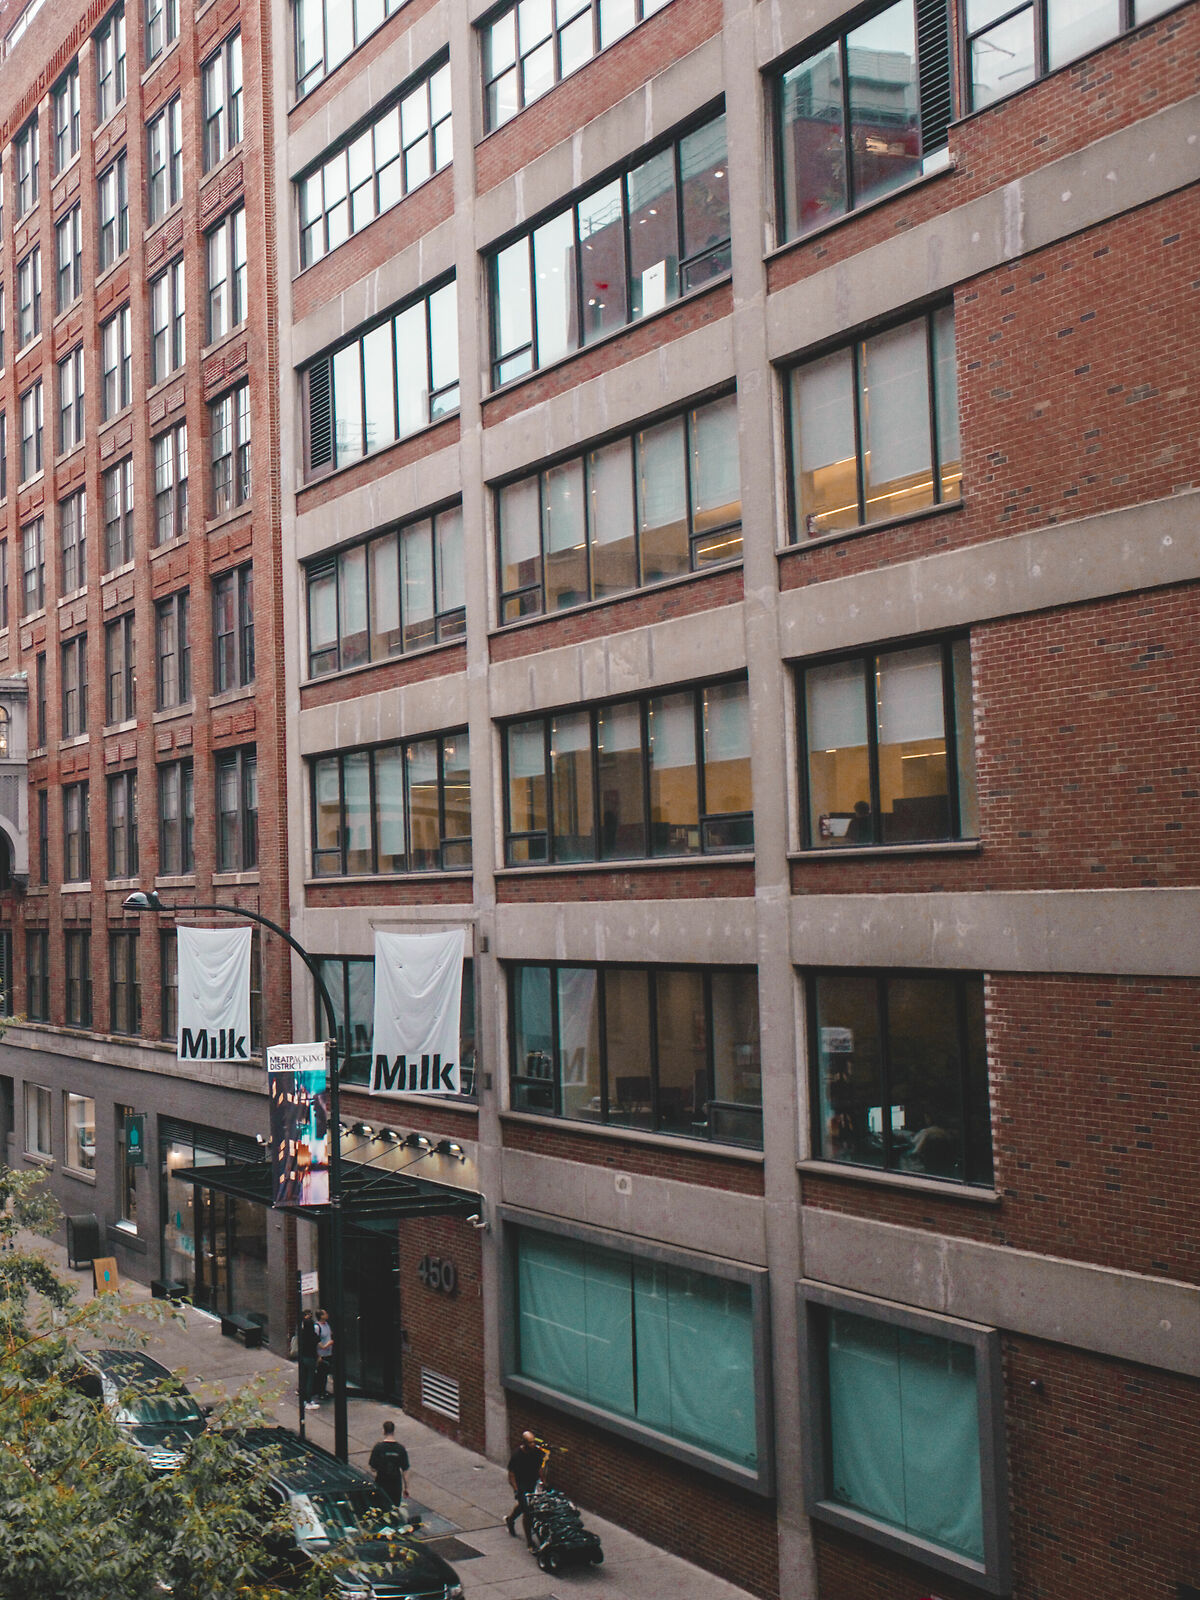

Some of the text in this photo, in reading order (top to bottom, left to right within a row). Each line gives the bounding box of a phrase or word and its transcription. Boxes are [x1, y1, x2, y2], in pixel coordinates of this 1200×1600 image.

[181, 1028, 247, 1059] Milk
[270, 1055, 323, 1063] MEATPACKING
[270, 1063, 301, 1071] DISTRICT
[374, 1053, 455, 1091] Milk
[417, 1254, 455, 1292] 450
